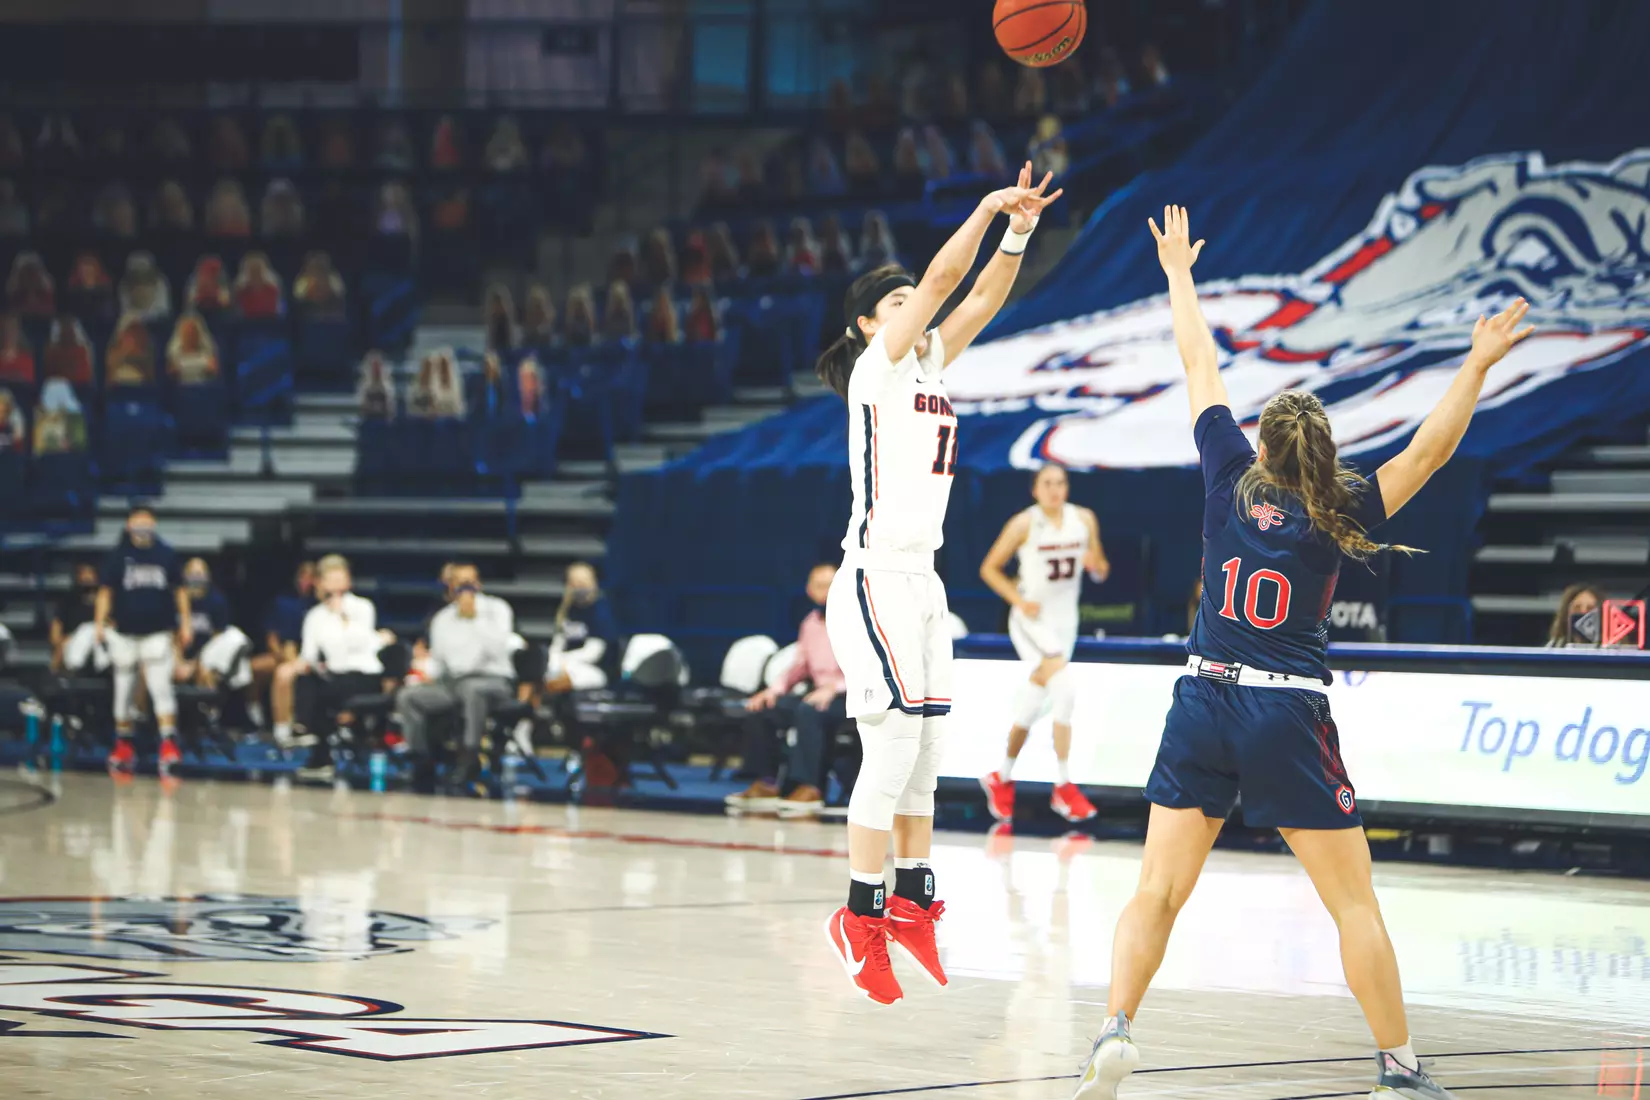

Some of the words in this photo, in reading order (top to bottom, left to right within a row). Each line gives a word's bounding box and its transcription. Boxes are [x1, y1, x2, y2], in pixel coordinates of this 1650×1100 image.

[1218, 556, 1291, 630] 10
[1460, 700, 1540, 772] Top
[1555, 705, 1650, 785] dog
